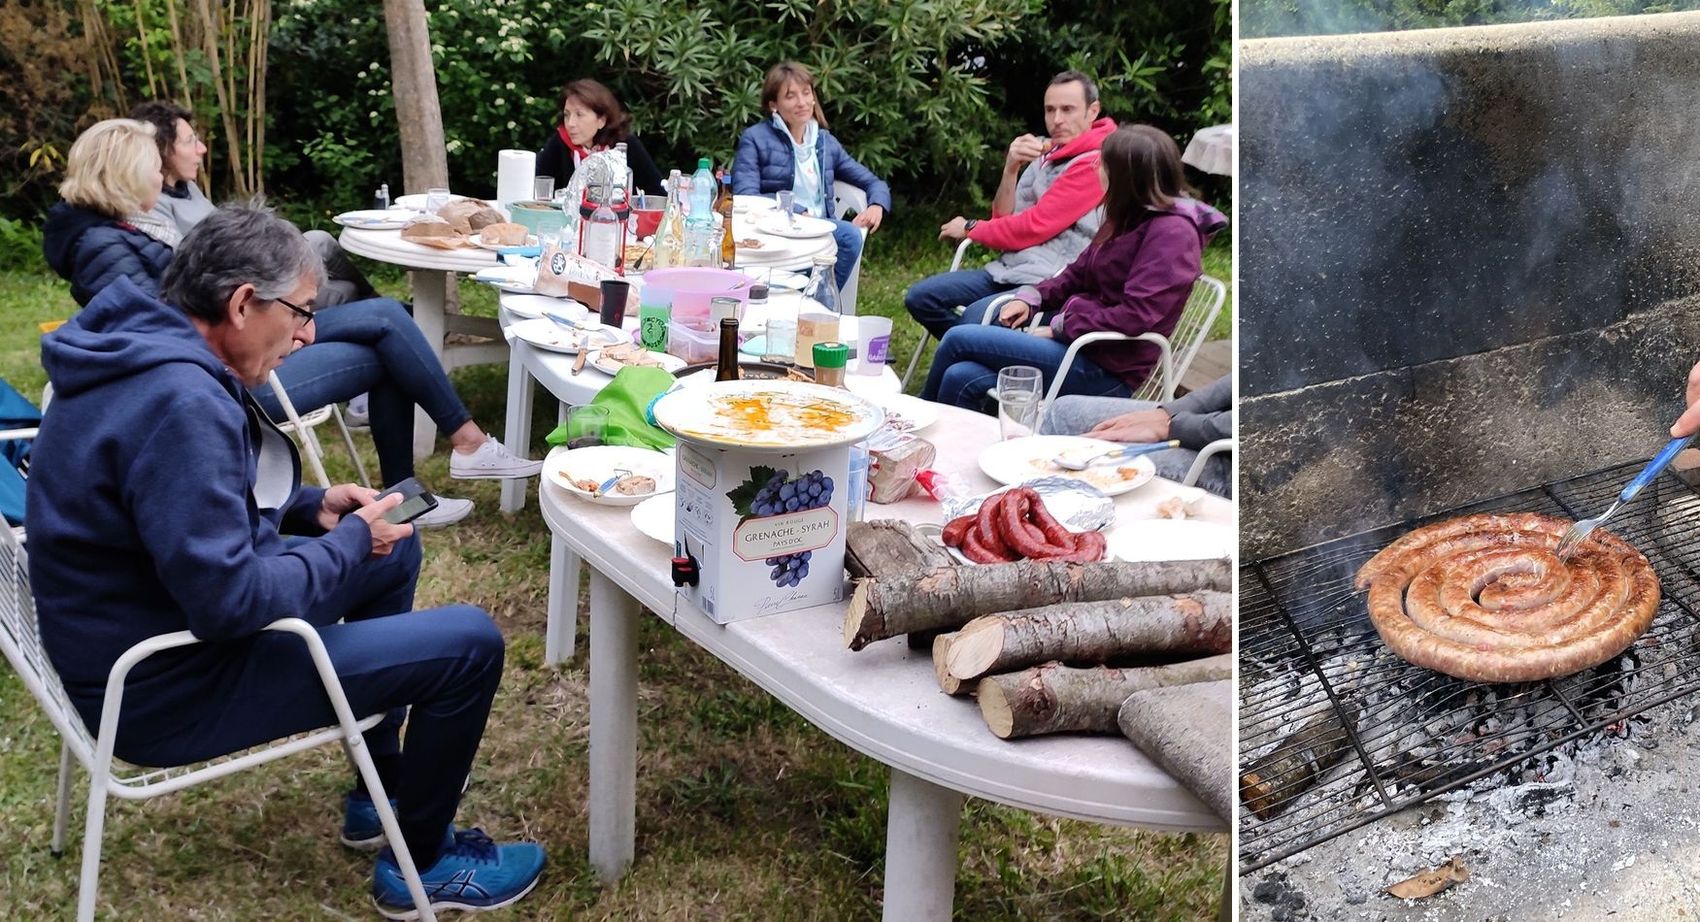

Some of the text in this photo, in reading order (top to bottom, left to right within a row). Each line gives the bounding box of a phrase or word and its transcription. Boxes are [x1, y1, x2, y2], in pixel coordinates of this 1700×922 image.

[745, 527, 794, 543] GRENACHE
[801, 520, 830, 534] SYRAH
[773, 539, 788, 548] PAYS
